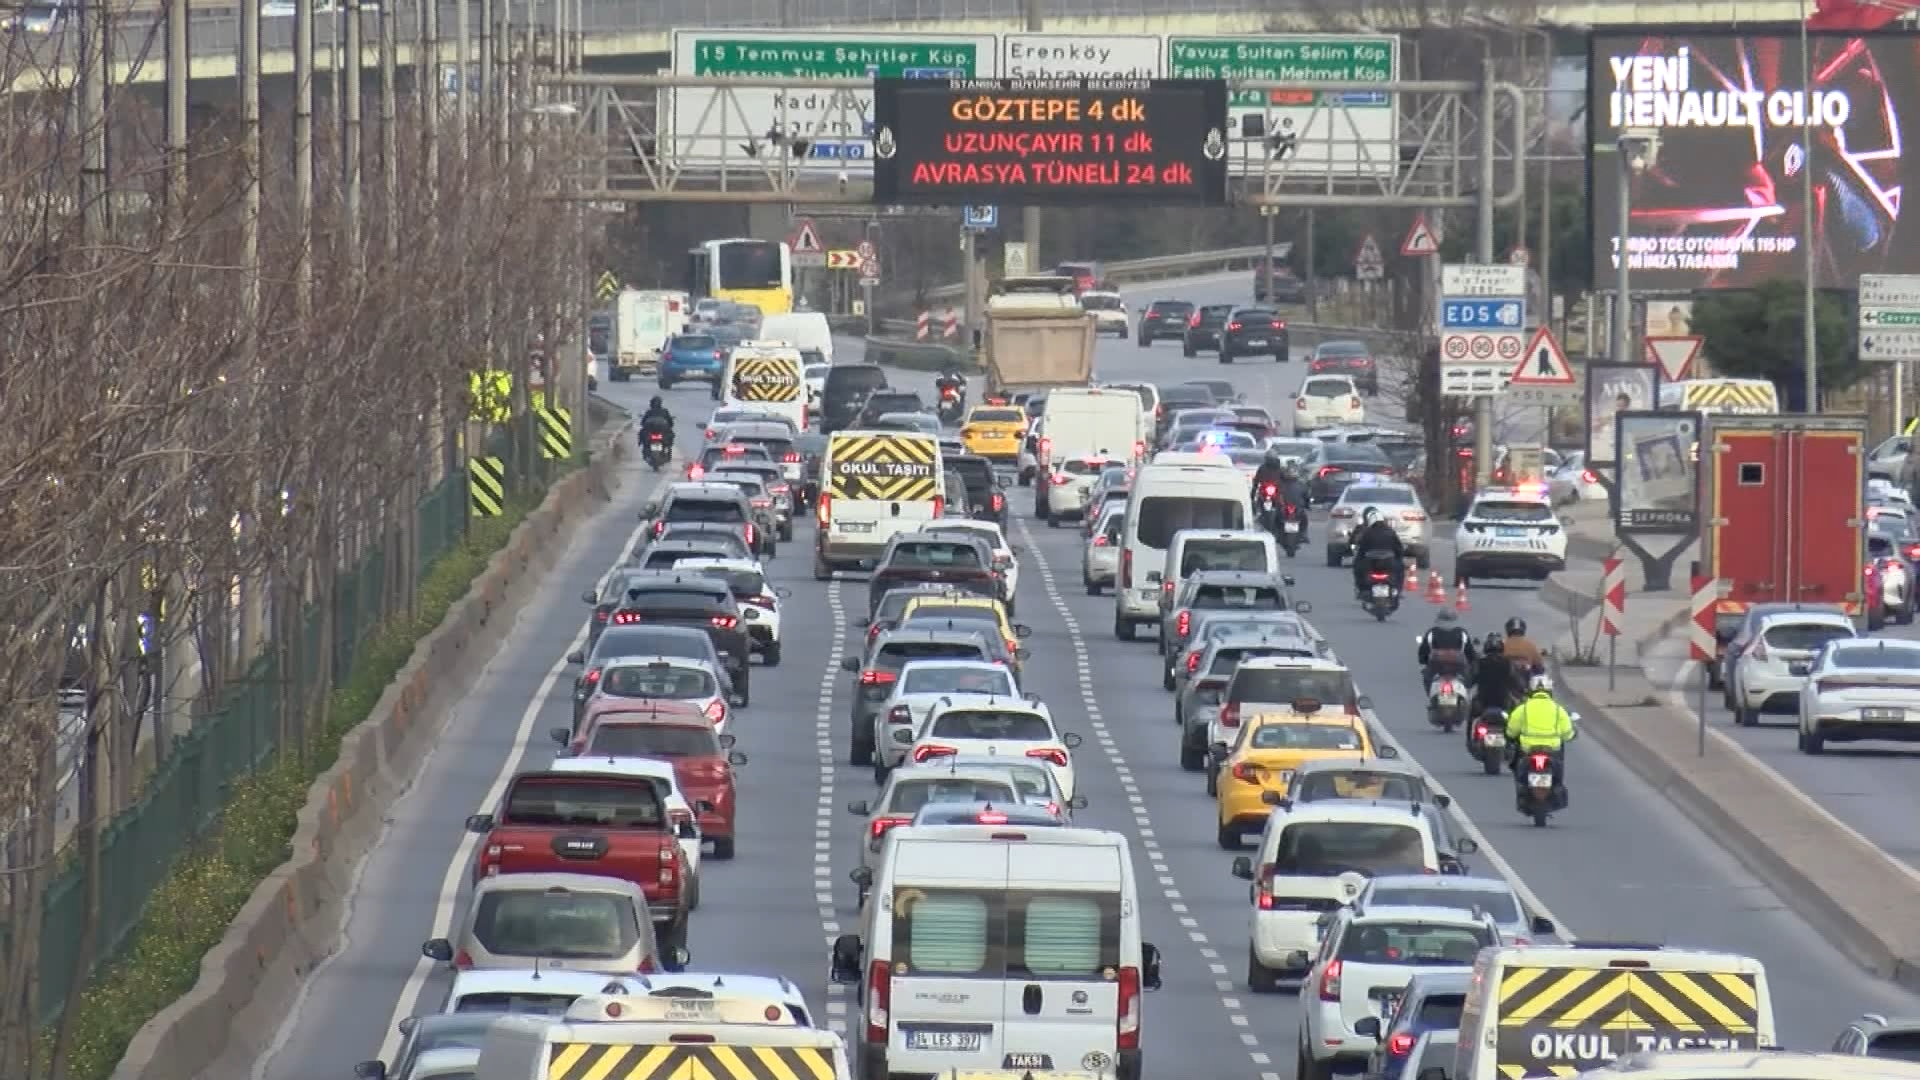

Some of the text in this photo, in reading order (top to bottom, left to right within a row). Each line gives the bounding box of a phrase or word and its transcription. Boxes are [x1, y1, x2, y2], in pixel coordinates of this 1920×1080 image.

[701, 46, 725, 61] 15
[736, 46, 825, 61] Temmuz
[835, 46, 918, 65] Şehitler
[1011, 43, 1111, 67] Erenköy
[1174, 45, 1229, 60] Yavuz
[1237, 45, 1293, 60] Sultan
[1300, 46, 1348, 60] Selim
[1174, 66, 1216, 81] Fatih
[1220, 66, 1274, 81] Sultan
[1280, 66, 1349, 81] Mehmet
[1610, 46, 1689, 91] YENİ
[952, 96, 1145, 121] GÖZTEPE 4 dk
[1610, 91, 1764, 127] RENAULT
[945, 131, 1153, 157] UZUNÇAYIR 11 dk
[913, 160, 1192, 184] AVRASYA TÜNELİ 24 dk
[1776, 238, 1796, 252] HP
[1447, 305, 1489, 322] EDS
[840, 462, 880, 474] OKUL
[1634, 511, 1692, 523] SEPHORA
[932, 1033, 952, 1047] LES
[1531, 1033, 1617, 1060] OKUL
